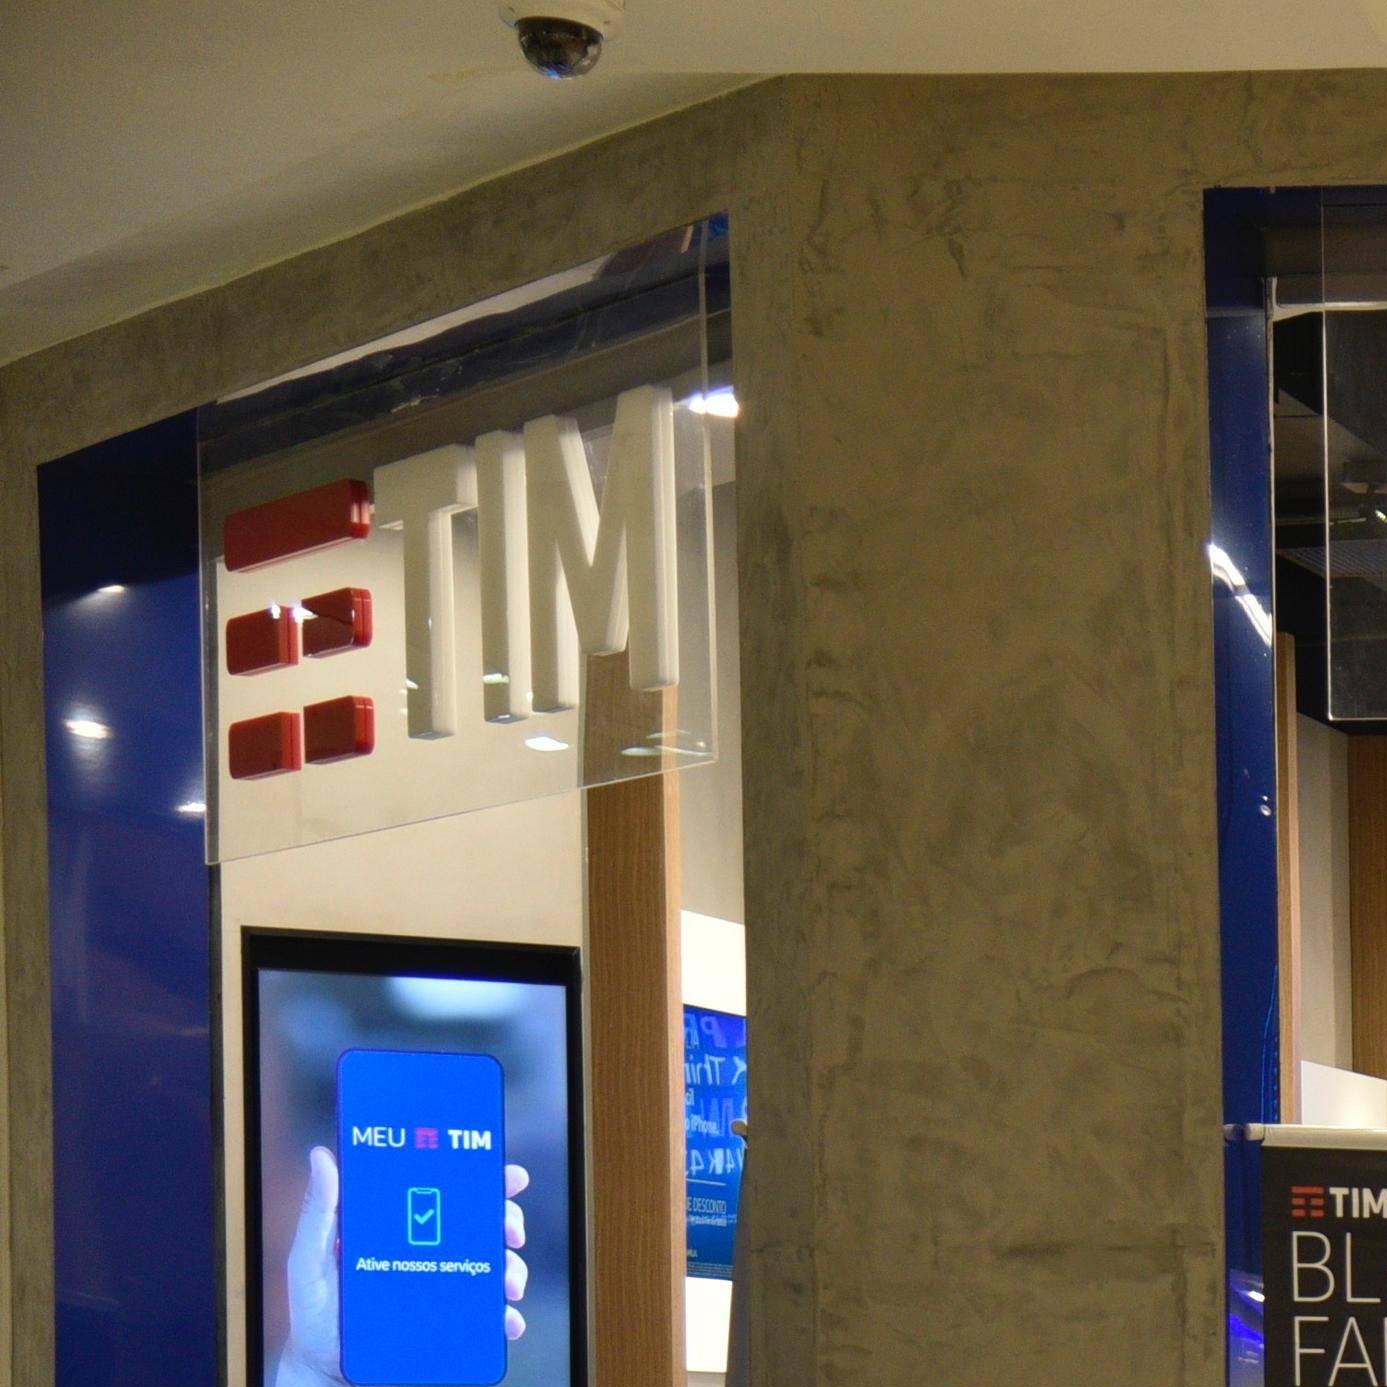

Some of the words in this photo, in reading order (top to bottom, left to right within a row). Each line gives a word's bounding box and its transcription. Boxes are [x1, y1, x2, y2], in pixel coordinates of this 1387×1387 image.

[373, 384, 679, 740] TIM
[352, 1127, 405, 1148] MEU
[448, 1129, 492, 1150] TIM
[693, 1198, 727, 1214] DESCONTO
[356, 1257, 389, 1272] Ative
[393, 1260, 437, 1273] nossos
[439, 1258, 491, 1276] serviços
